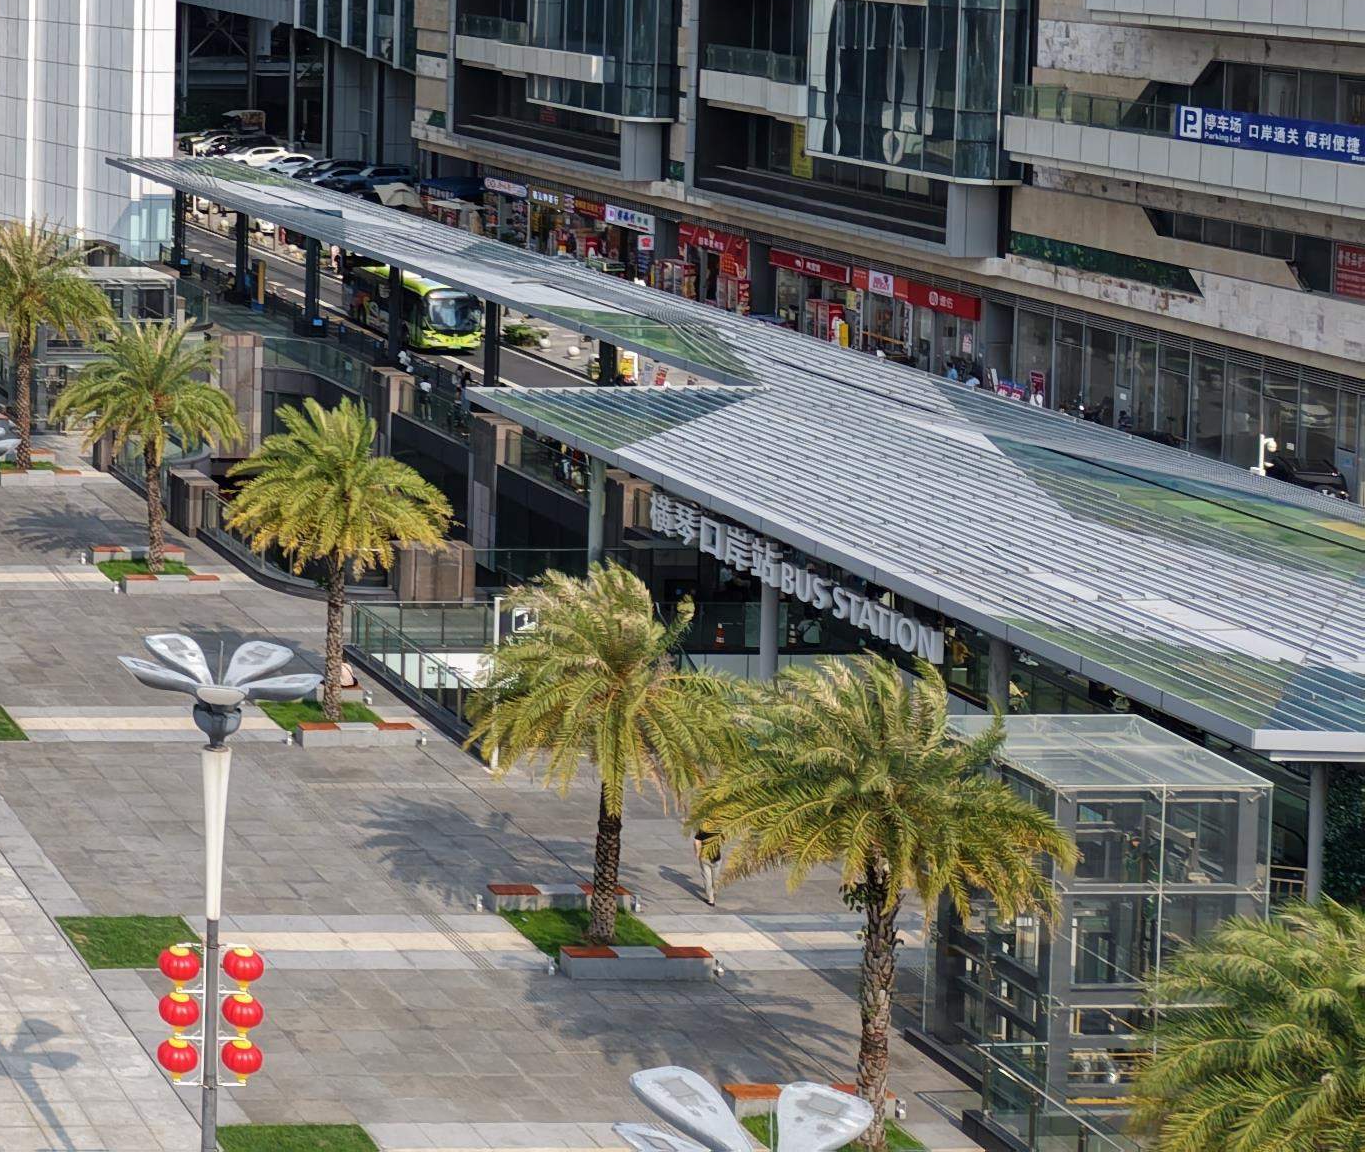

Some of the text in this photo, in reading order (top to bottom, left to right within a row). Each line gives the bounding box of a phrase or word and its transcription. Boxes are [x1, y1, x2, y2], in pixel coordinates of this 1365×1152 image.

[1204, 113, 1361, 155] 停车场 口岸通关 便利便捷
[1204, 131, 1241, 144] Parking Lot
[650, 490, 783, 588] 横琴口岸站
[781, 560, 945, 665] BUS STATION
